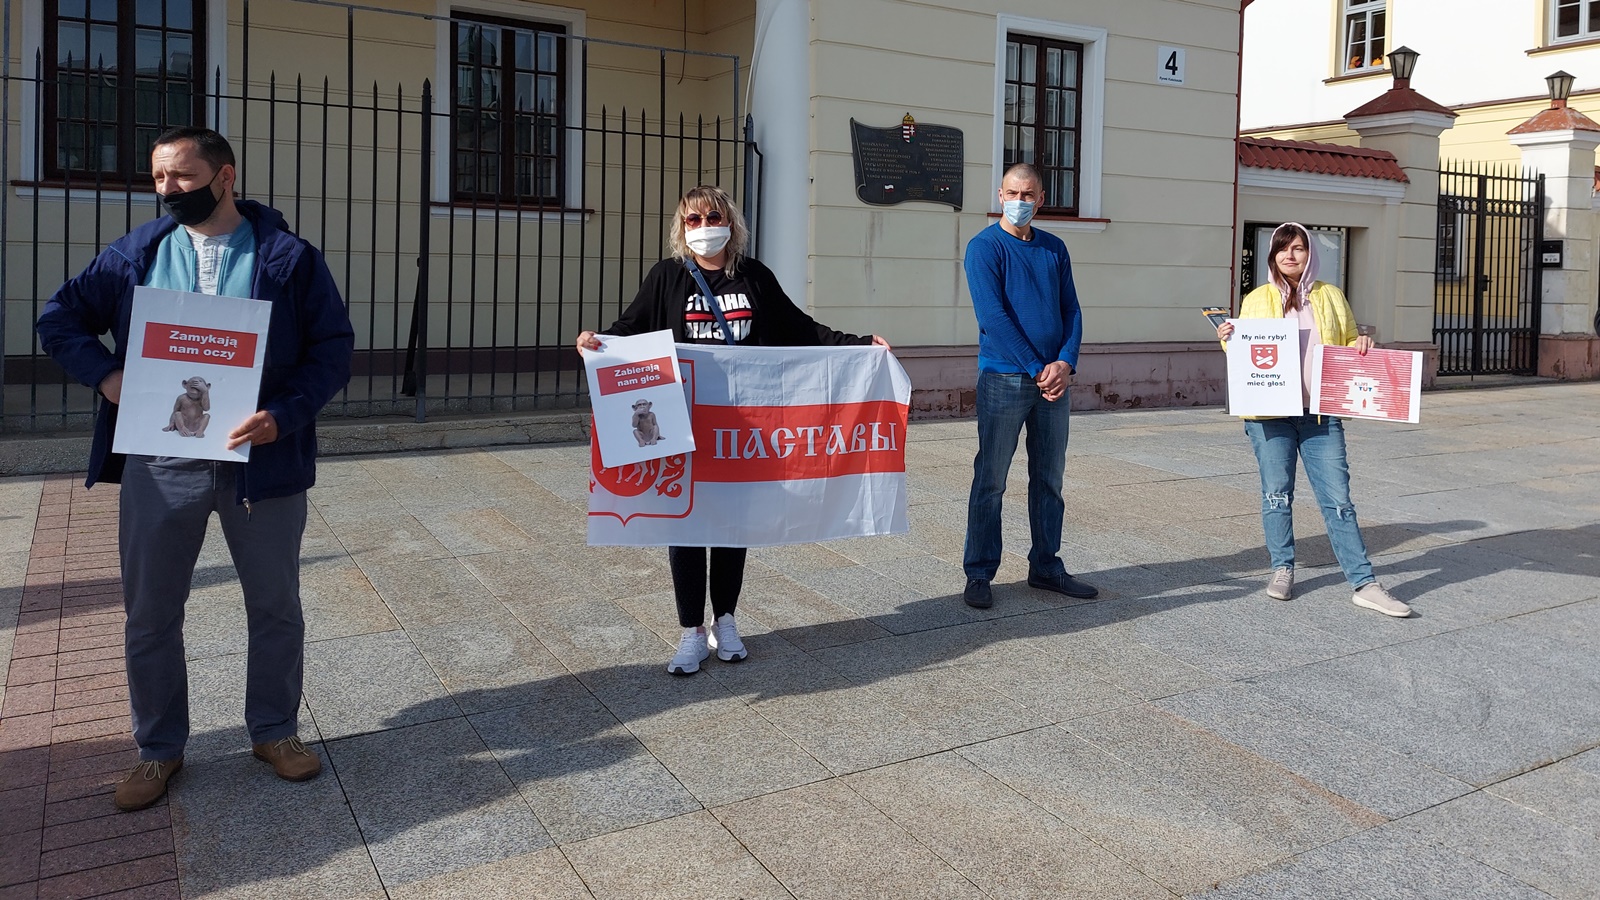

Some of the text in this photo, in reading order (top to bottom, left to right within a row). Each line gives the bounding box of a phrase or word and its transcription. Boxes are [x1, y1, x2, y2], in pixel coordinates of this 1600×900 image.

[1165, 50, 1178, 75] 4
[169, 330, 238, 348] Zamykają
[169, 345, 235, 360] nam oczy
[614, 364, 661, 377] Zabierają
[617, 378, 638, 387] nam
[712, 422, 898, 459] ПАСТАВЫ
